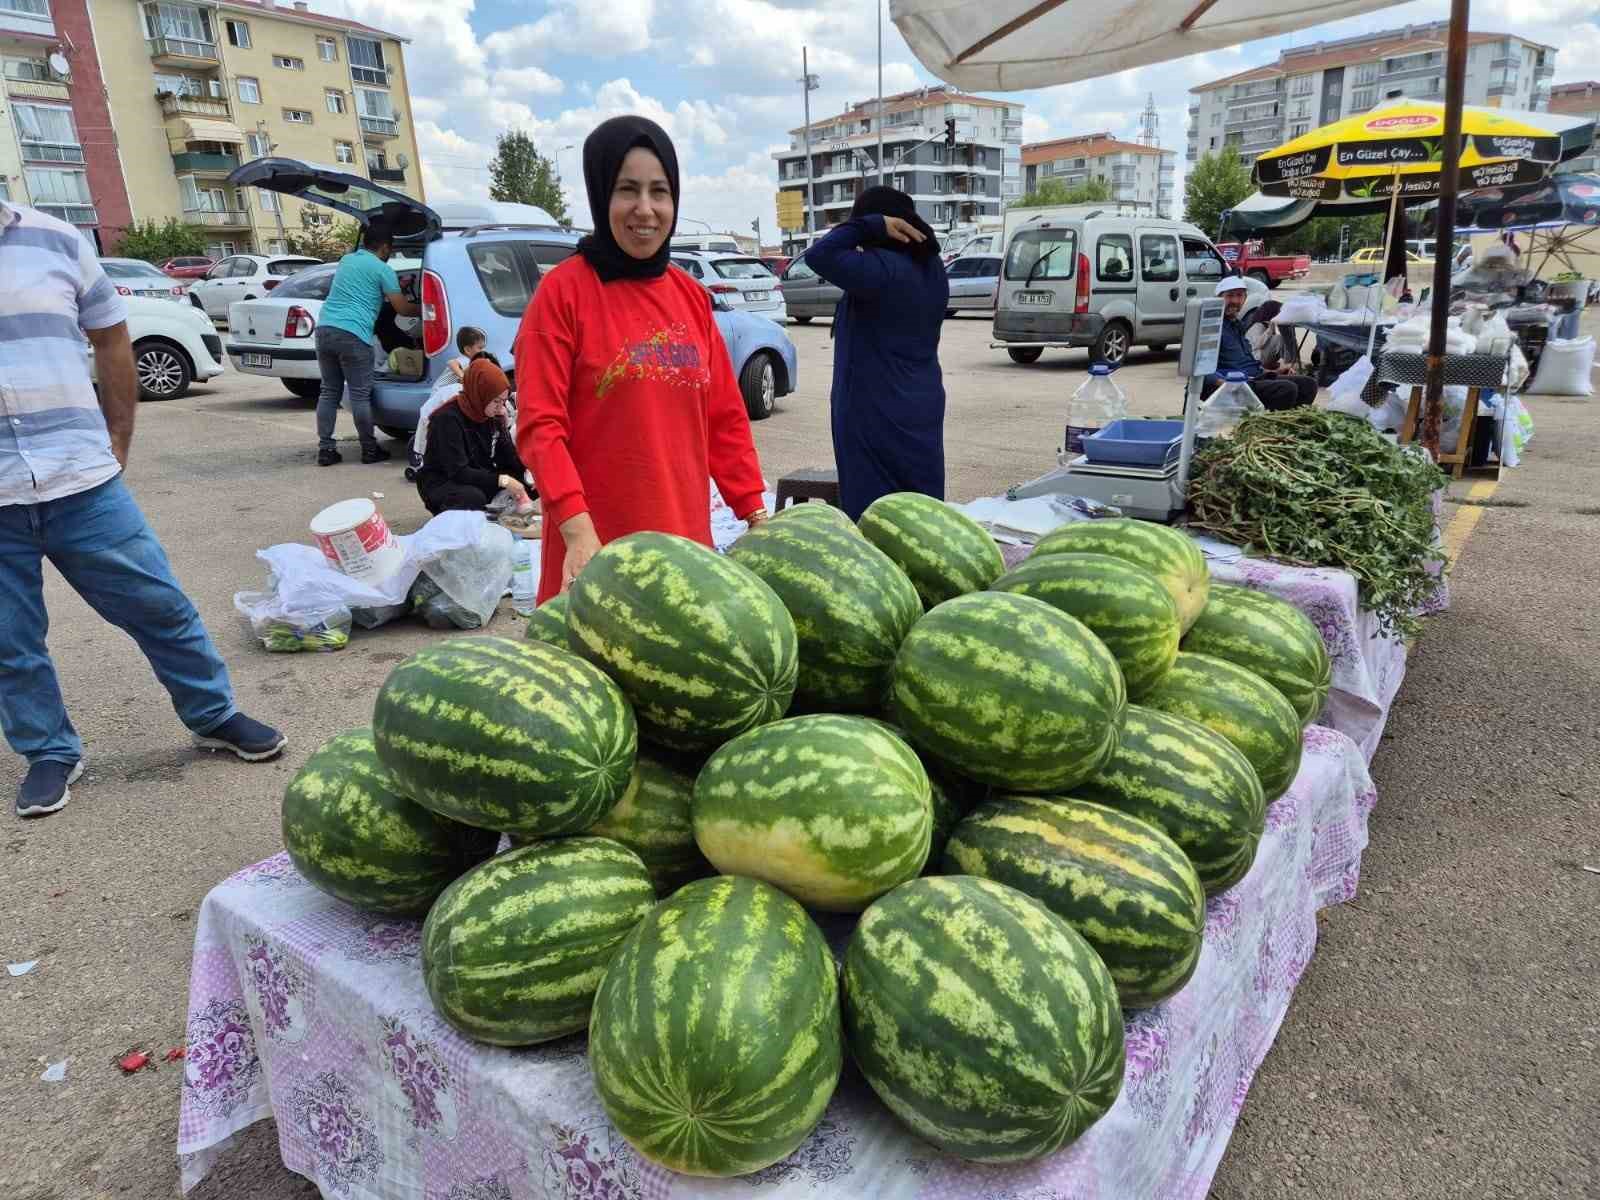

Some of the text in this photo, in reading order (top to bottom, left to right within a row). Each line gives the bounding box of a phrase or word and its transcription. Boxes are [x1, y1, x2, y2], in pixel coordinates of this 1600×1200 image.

[1277, 152, 1317, 169] En Güzel Çay
[1340, 147, 1424, 162] En Güzel Çay...
[1300, 165, 1313, 176] Çay
